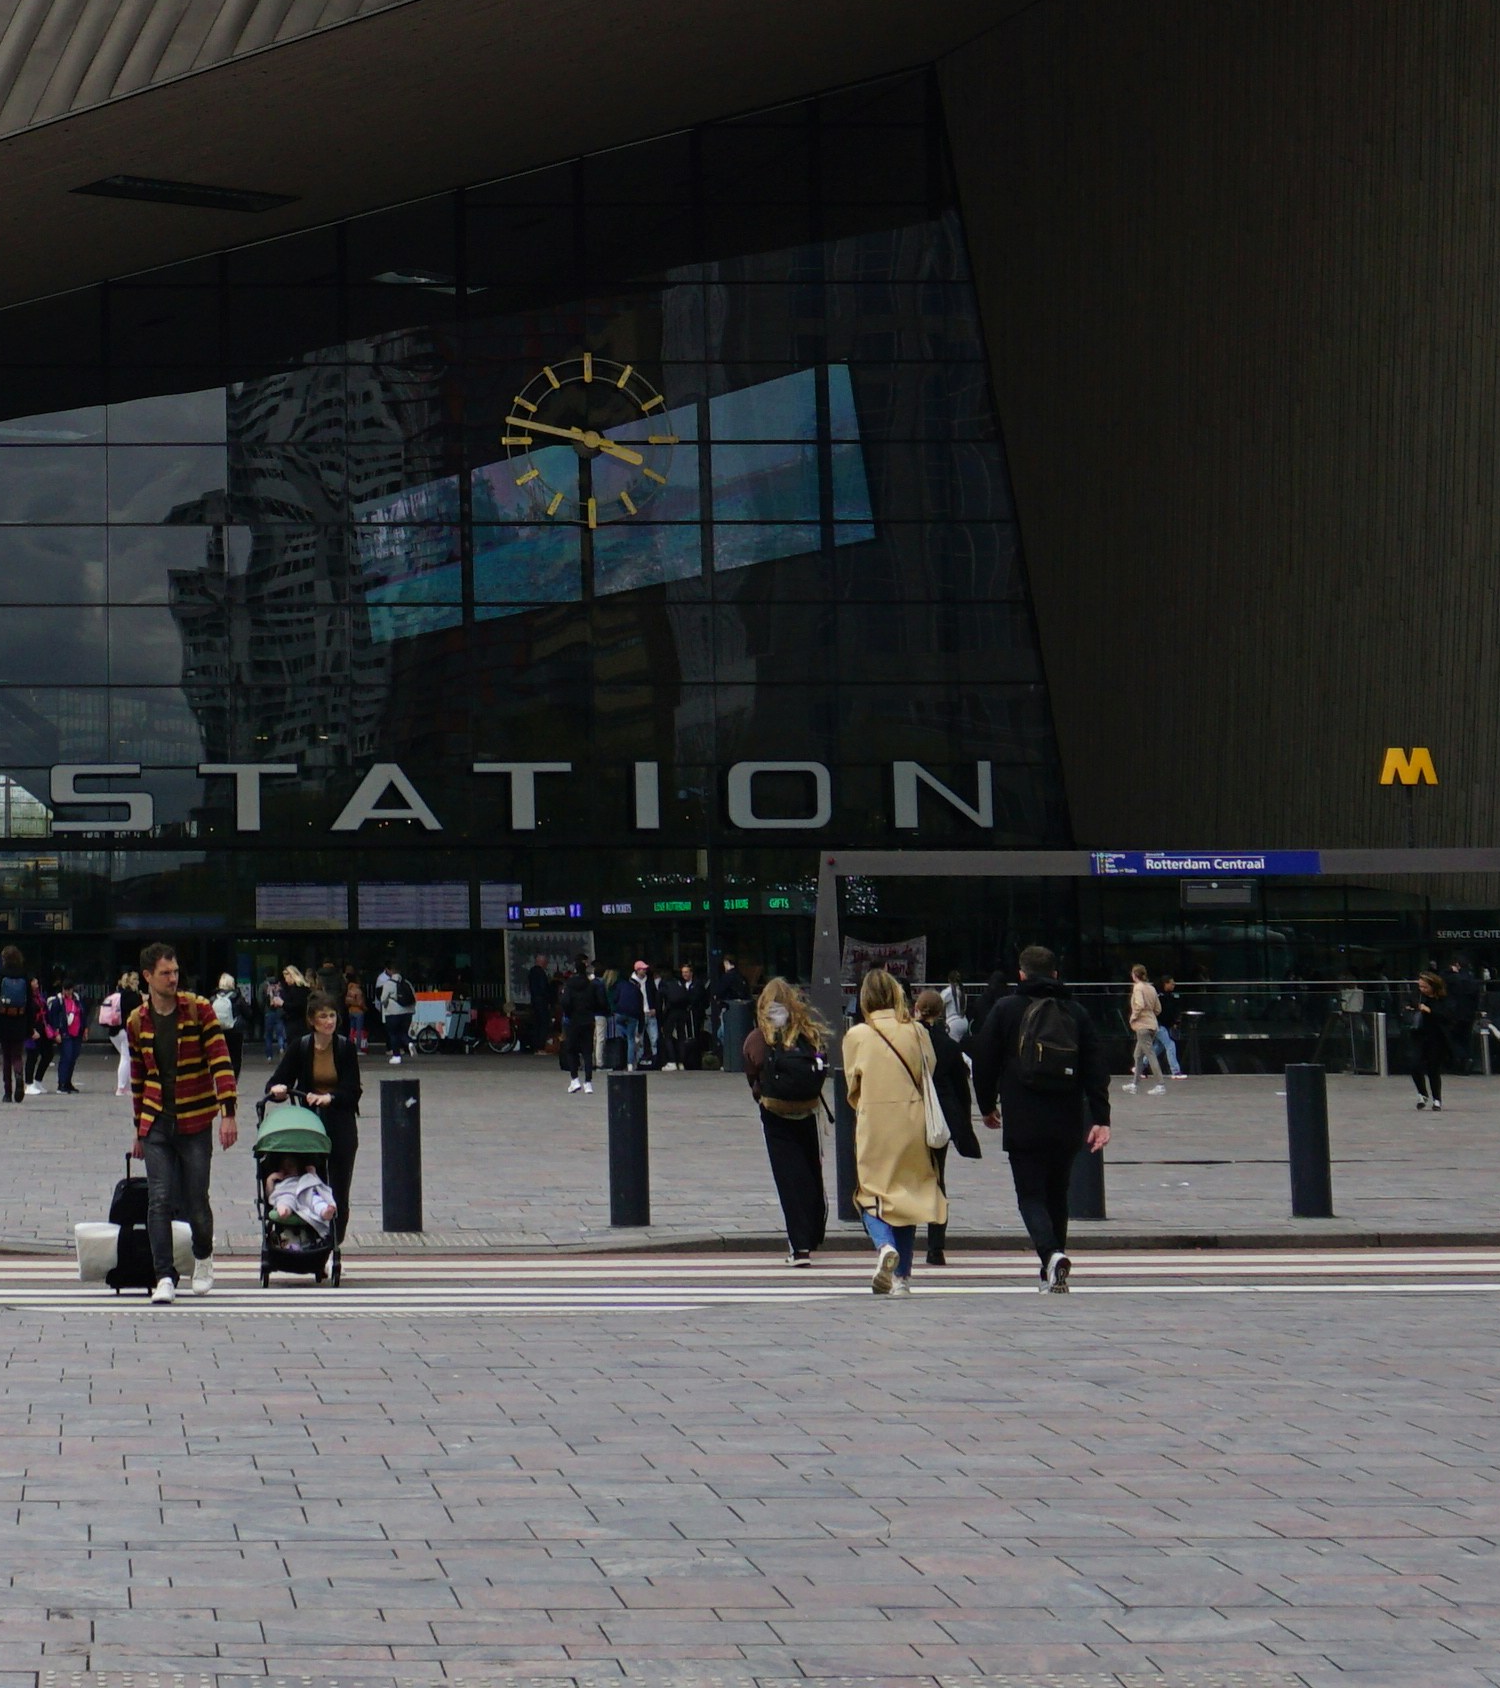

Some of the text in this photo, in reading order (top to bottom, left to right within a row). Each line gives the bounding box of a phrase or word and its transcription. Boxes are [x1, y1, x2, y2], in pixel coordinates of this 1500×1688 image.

[50, 761, 993, 832] STATION
[1145, 858, 1265, 870] Rotterdam Centraal
[769, 897, 790, 909] GIFTS
[1437, 930, 1471, 939] SERVICE
